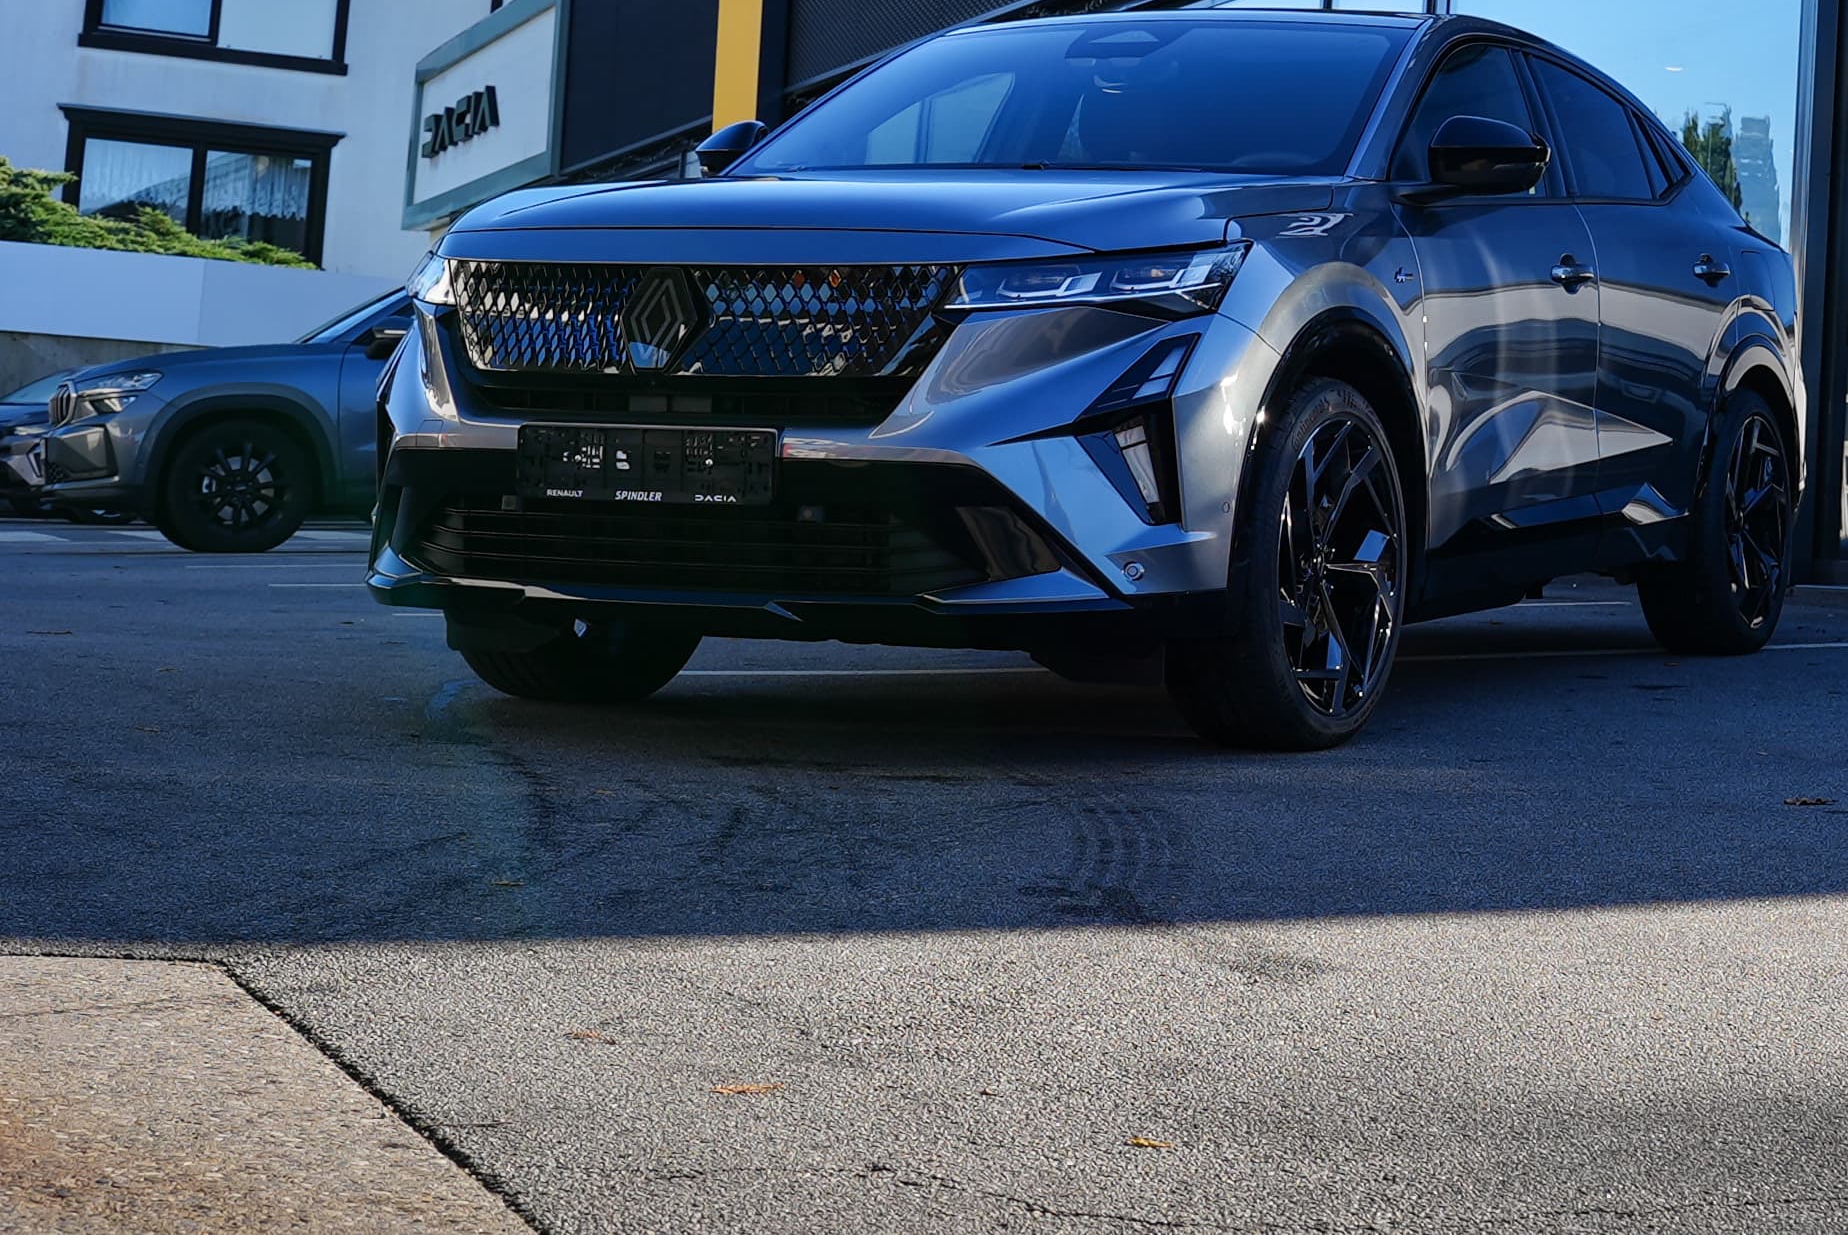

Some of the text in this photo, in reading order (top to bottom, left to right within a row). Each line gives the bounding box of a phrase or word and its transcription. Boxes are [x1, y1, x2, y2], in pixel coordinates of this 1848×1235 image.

[546, 489, 584, 498] RENAULT
[615, 490, 663, 502] SPINDLER
[694, 494, 737, 503] DACIA
